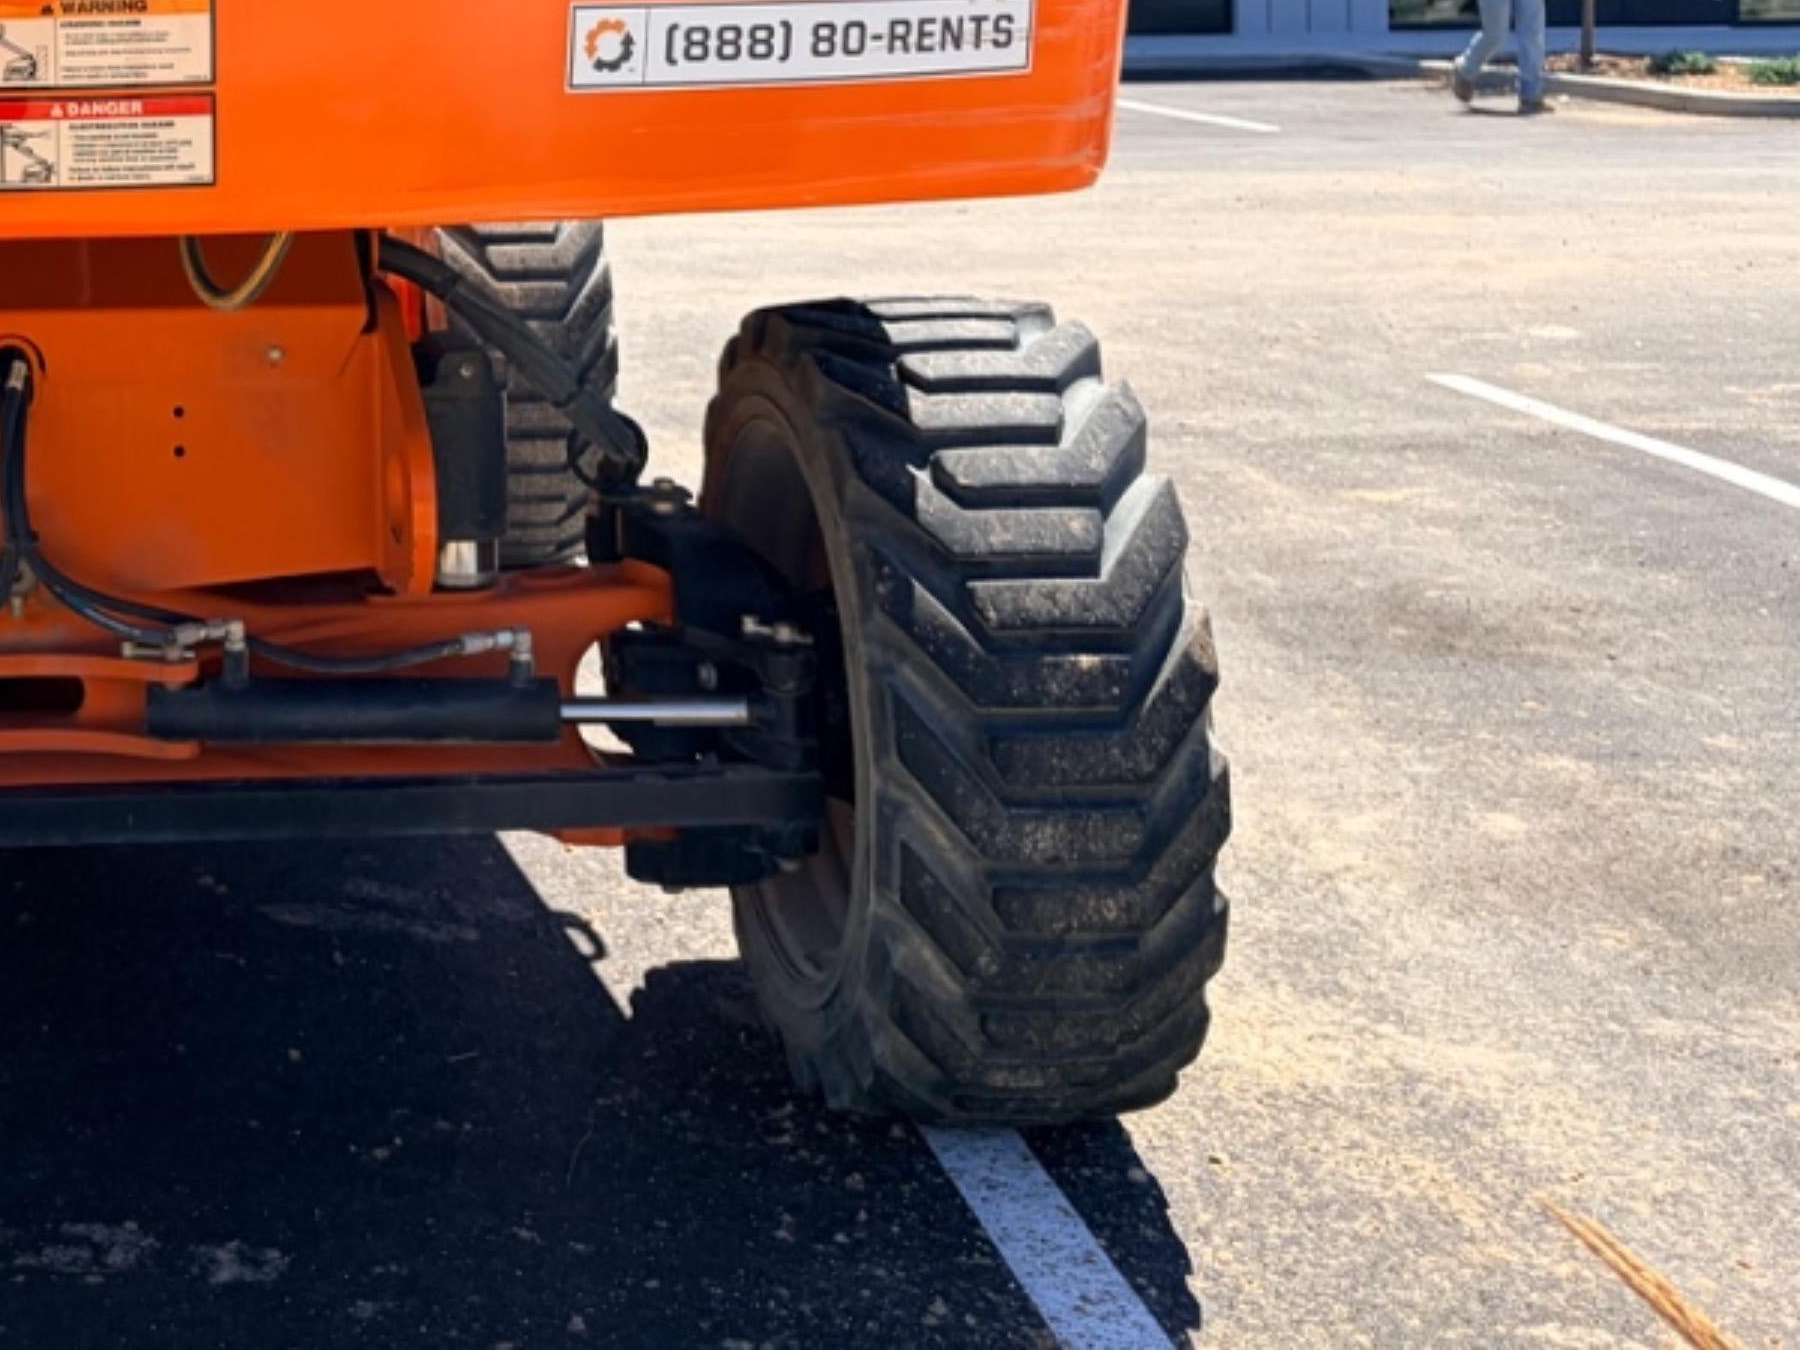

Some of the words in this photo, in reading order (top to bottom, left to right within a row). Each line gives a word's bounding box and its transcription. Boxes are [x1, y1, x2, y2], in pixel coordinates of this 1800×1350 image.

[665, 20, 793, 66] (888)
[810, 13, 1015, 58] 80-RENTS
[68, 101, 143, 116] DANGER
